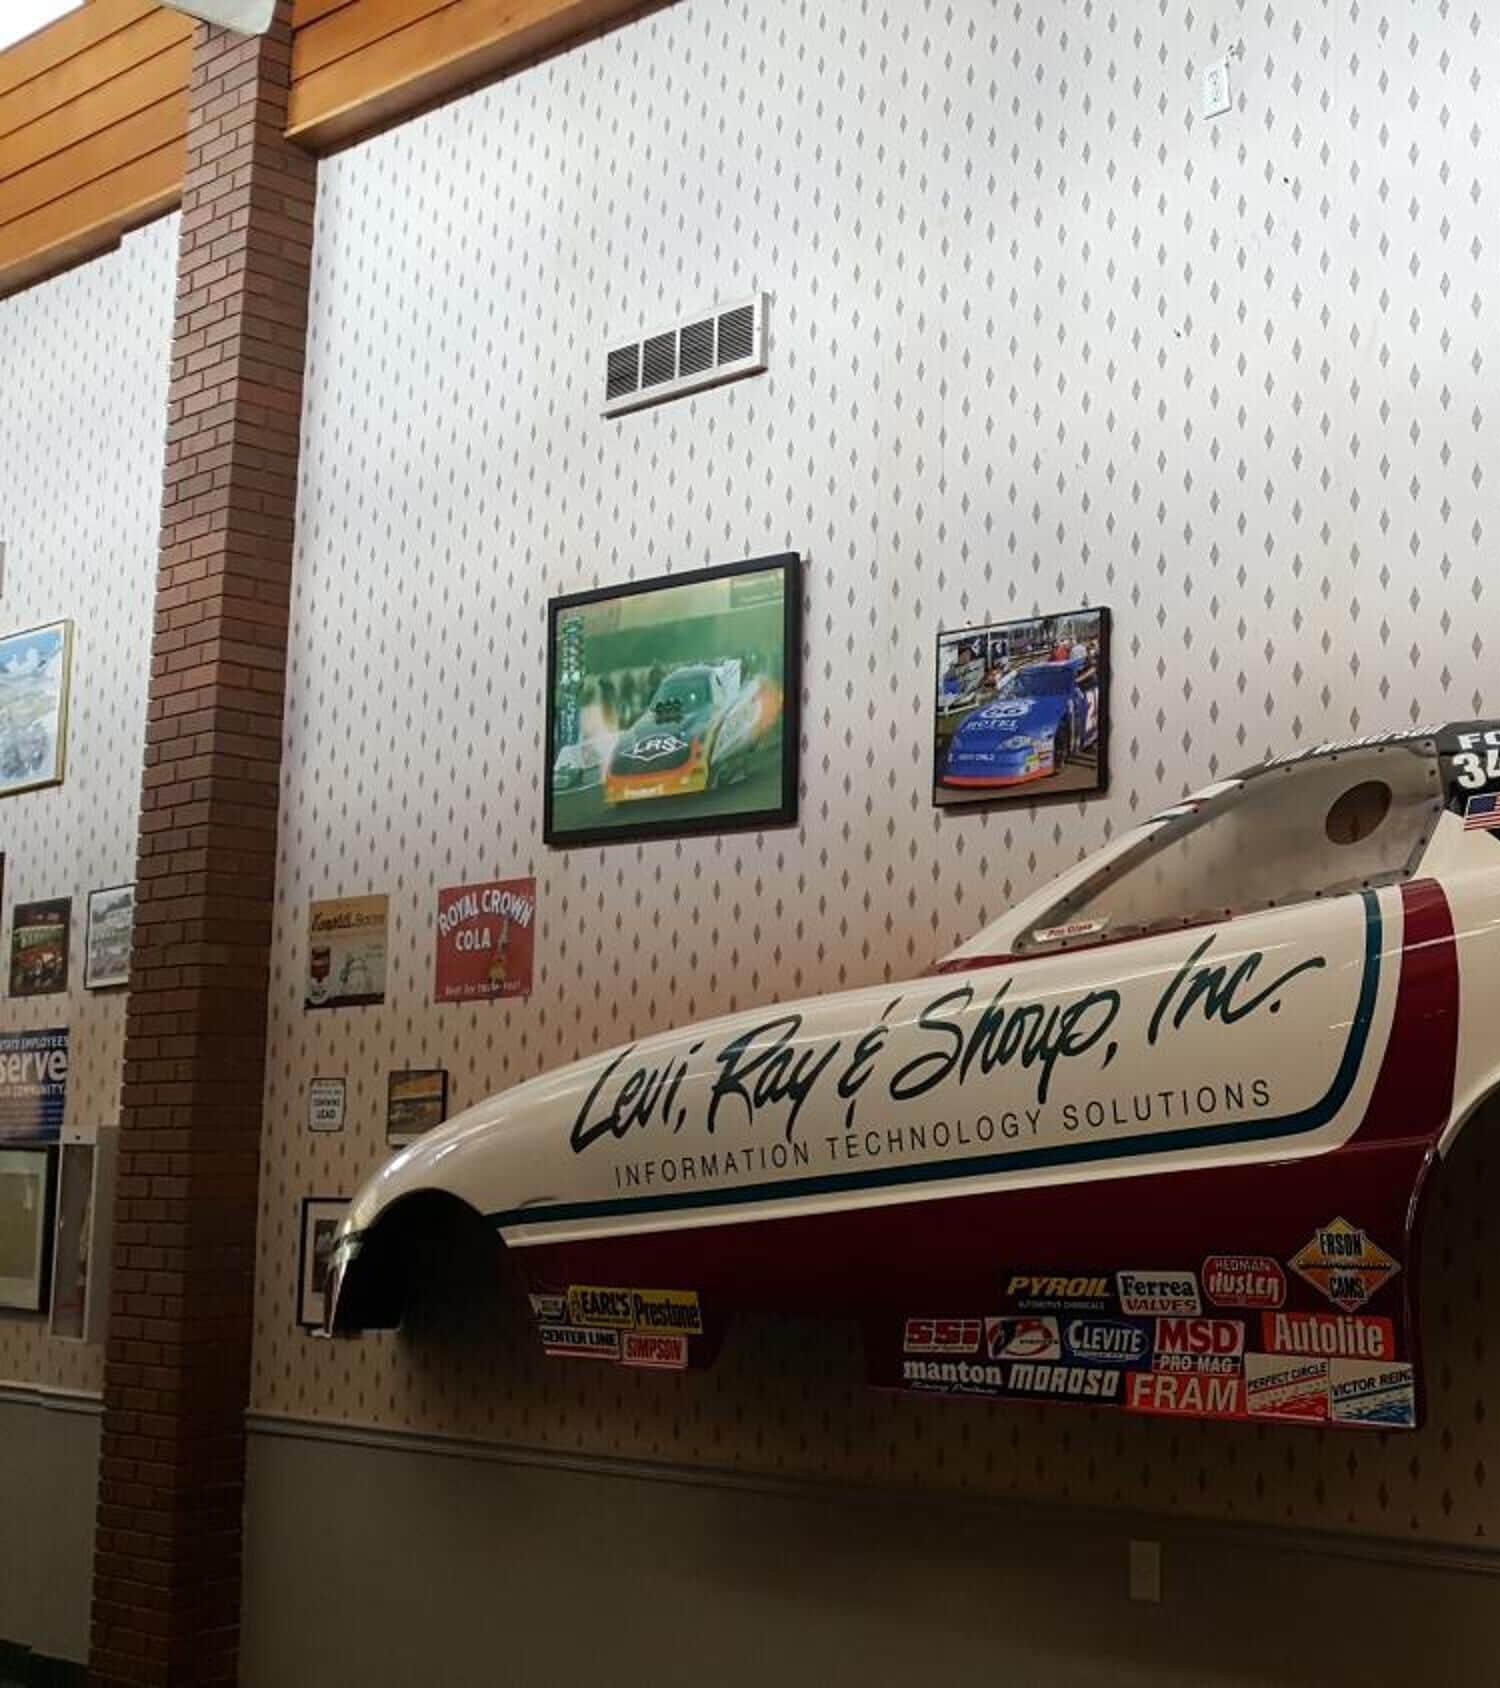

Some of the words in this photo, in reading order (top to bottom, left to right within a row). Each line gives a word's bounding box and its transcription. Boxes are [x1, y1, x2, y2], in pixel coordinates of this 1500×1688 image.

[438, 890, 480, 937] ROYAL
[481, 889, 535, 929] CROWN
[455, 928, 492, 952] COLA
[570, 1041, 705, 1154] Levi,
[707, 1014, 842, 1143] Ray
[889, 976, 1121, 1104] Shoup,
[1148, 932, 1327, 1046] Inc.
[615, 1140, 810, 1190] INFORMATION
[825, 1109, 1042, 1161] TECHNOLOGY
[1062, 1078, 1271, 1131] SOLUTIONS
[1005, 1276, 1111, 1297] PYROIL
[1119, 1275, 1195, 1298] Ferrea
[1124, 1299, 1198, 1312] VALVES
[626, 1336, 684, 1362] SIMPSON
[1069, 1320, 1145, 1353] CLEVITE
[1158, 1320, 1240, 1354] MSD
[1275, 1313, 1384, 1357] Autolite
[903, 1360, 1003, 1385] manton
[1008, 1363, 1121, 1398] MOROSO
[1291, 1361, 1327, 1378] CIRCLE
[1132, 1373, 1240, 1413] FRAM
